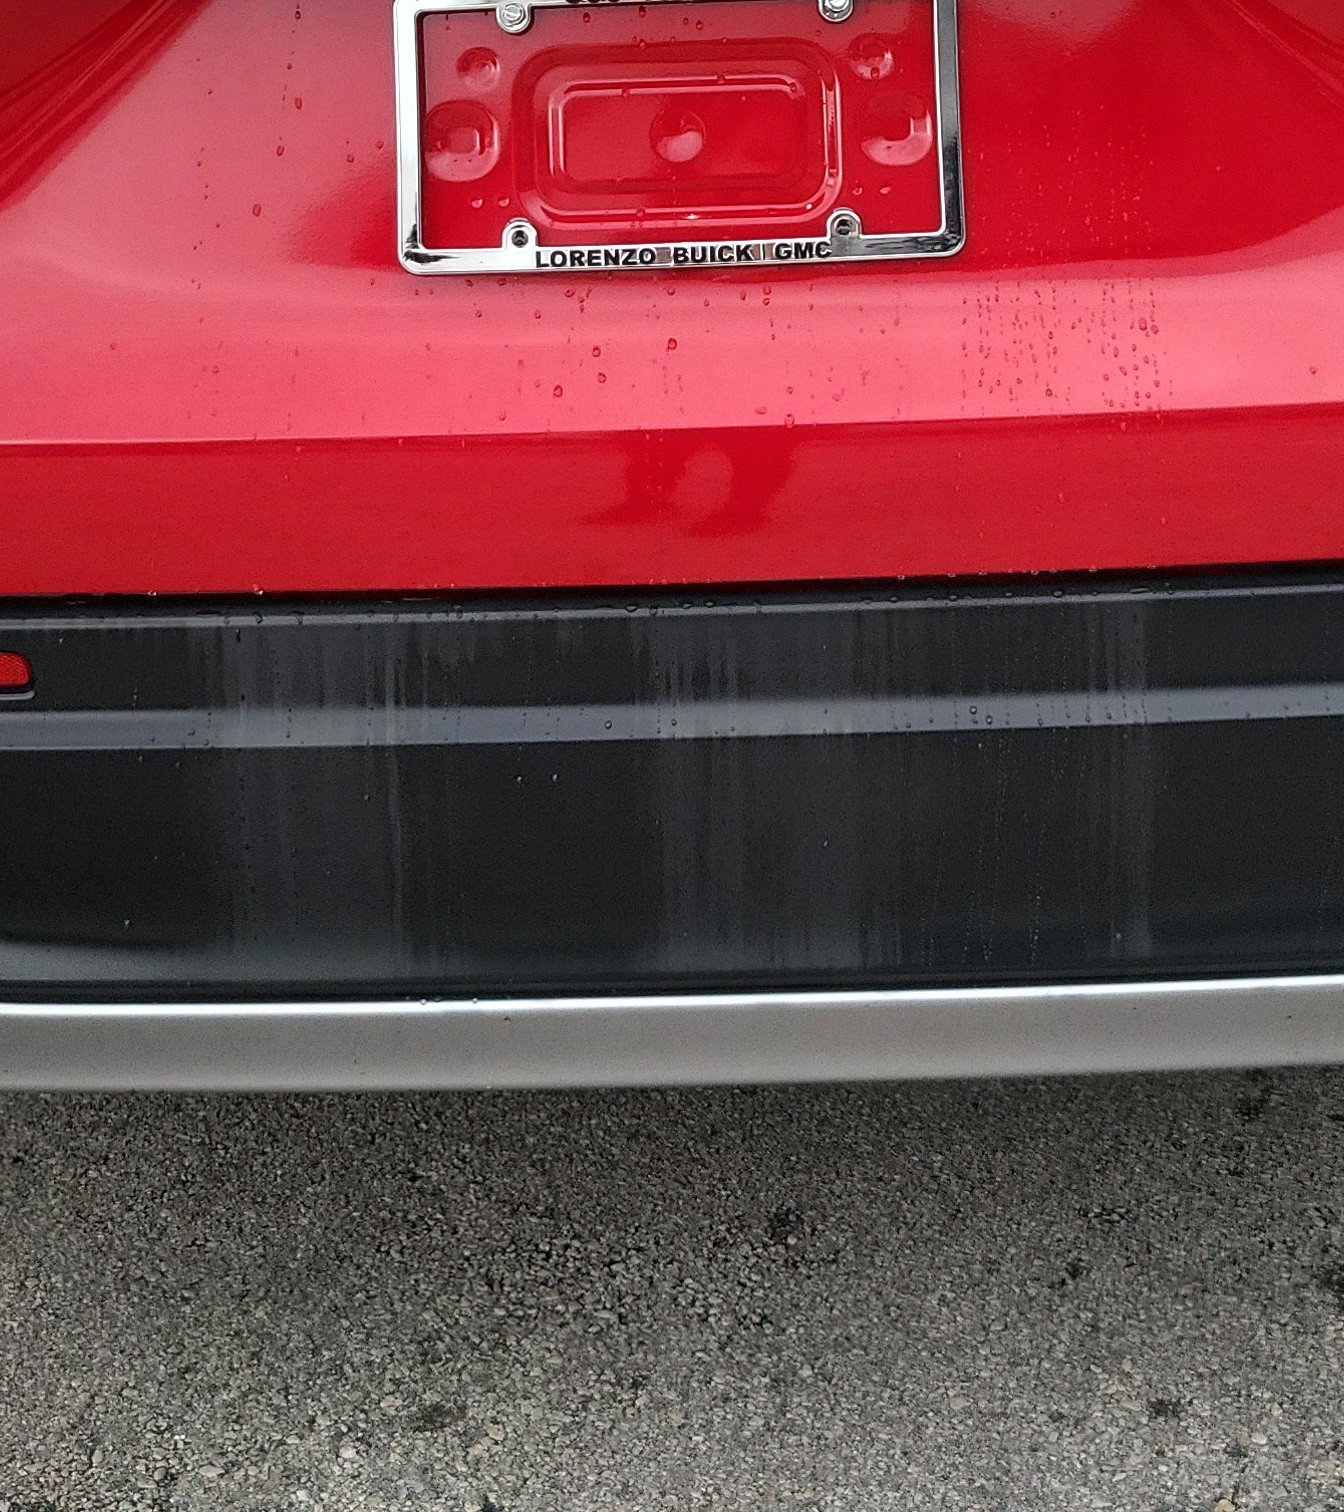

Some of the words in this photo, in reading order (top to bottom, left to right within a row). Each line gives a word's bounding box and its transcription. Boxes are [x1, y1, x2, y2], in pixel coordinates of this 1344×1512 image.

[535, 247, 657, 268] LORENZO
[672, 243, 754, 264] BUICK
[774, 240, 833, 260] GMC
